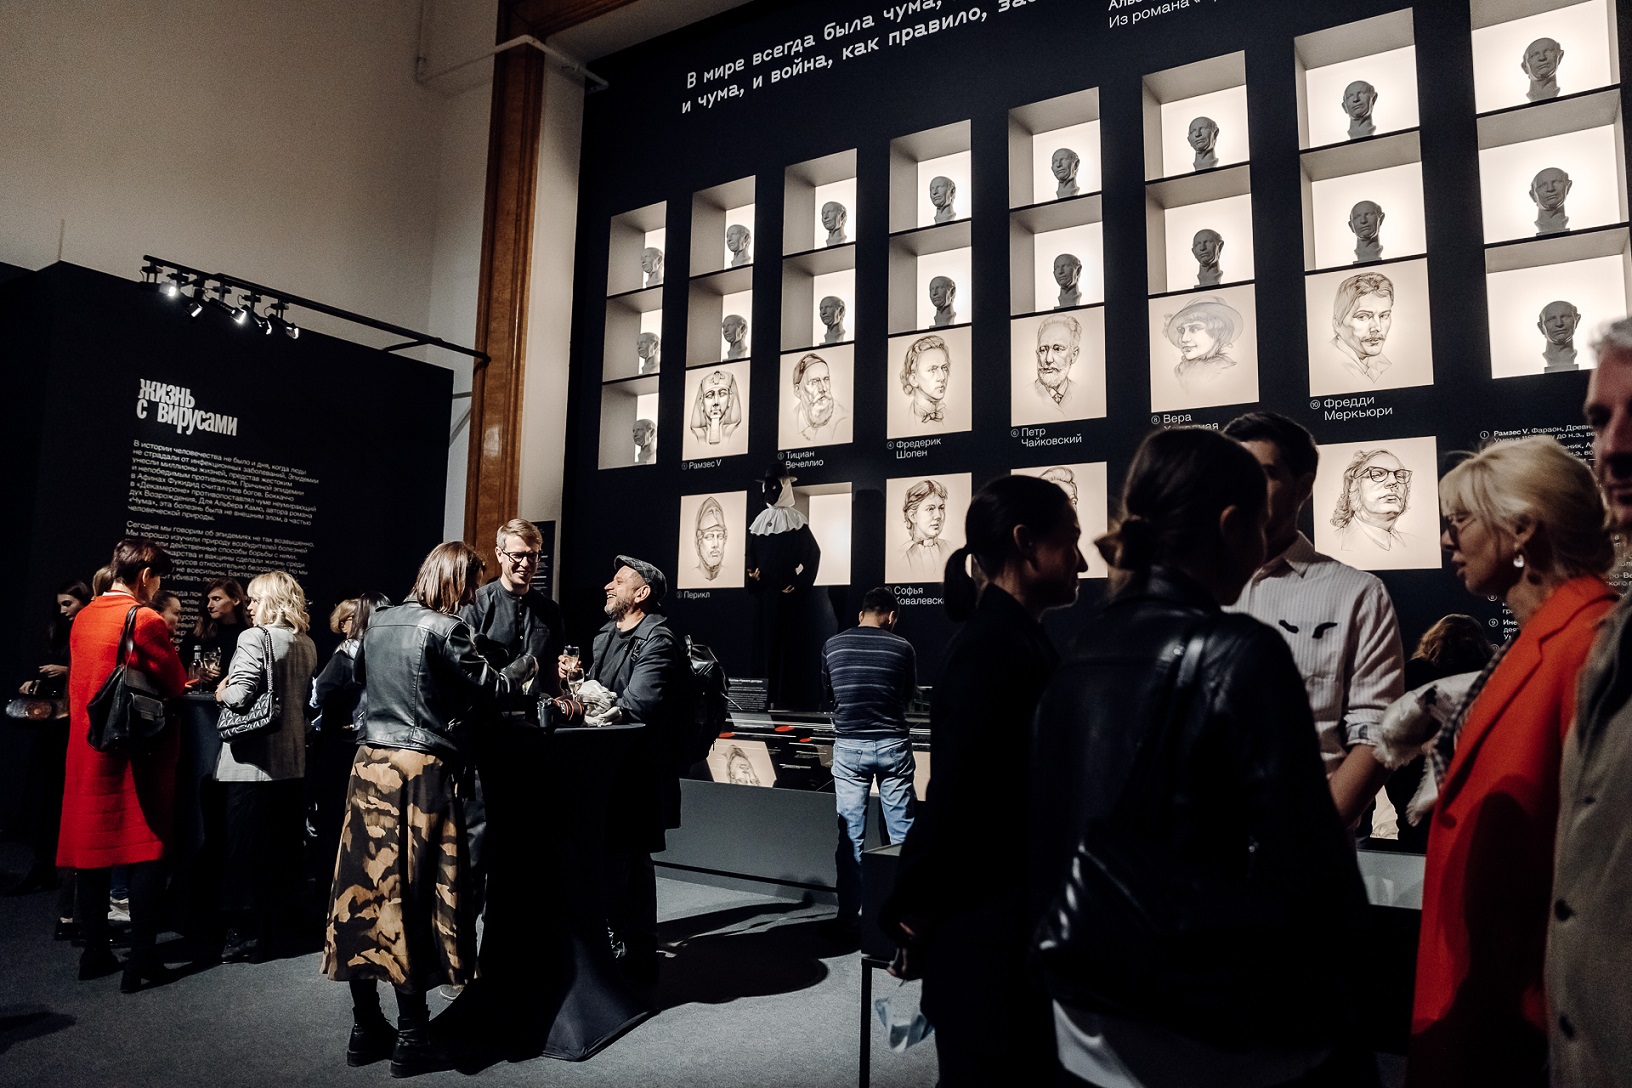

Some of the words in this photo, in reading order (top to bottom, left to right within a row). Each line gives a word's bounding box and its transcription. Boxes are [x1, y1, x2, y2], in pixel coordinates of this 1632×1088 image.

[1108, 14, 1129, 29] Из
[1132, 0, 1190, 25] романа
[686, 71, 697, 89] В
[703, 58, 745, 80] мире
[752, 34, 815, 66] всегда
[823, 15, 875, 41] была
[883, 0, 942, 22] чума,
[681, 100, 692, 114] и
[698, 84, 745, 108] чума,
[752, 75, 763, 89] и
[771, 54, 833, 84] война,
[842, 37, 880, 60] как
[888, 7, 988, 46] правило,
[1323, 396, 1375, 410] Фредди
[157, 402, 238, 436] вирусами
[1163, 413, 1192, 424] Вера
[1324, 407, 1393, 421] Меркьюри
[1021, 427, 1046, 437] Петр
[1493, 430, 1522, 438] Рамзес
[896, 438, 942, 449] Фредерик
[1021, 433, 1082, 447] Чайковский
[141, 443, 172, 452] истории
[173, 448, 222, 461] человечества
[233, 457, 250, 465] было
[786, 450, 815, 461] Тициан
[896, 450, 928, 460] Шопен
[144, 451, 180, 461] страдали
[191, 459, 241, 471] инфекционных
[288, 473, 319, 483] Эпидемии
[688, 460, 715, 470] Рамзес
[716, 459, 723, 468] V
[785, 459, 824, 469] Вечеллио
[161, 462, 198, 472] миллионы
[229, 473, 260, 482] представ
[262, 478, 292, 486] жестоким
[137, 473, 166, 483] Афинах
[168, 478, 200, 489] Фукидид
[201, 483, 225, 491] считал
[138, 467, 190, 478] непобедимым
[240, 480, 272, 490] Причиной
[274, 487, 304, 495] эпидемии
[174, 502, 204, 511] болезнь
[205, 506, 223, 514] была
[214, 500, 243, 509] Альбера
[273, 502, 316, 512] неумирающий
[128, 506, 180, 516] человеческой
[127, 521, 159, 530] Сегодня
[173, 527, 204, 535] говорим
[215, 532, 251, 540] эпидемиях
[170, 543, 217, 552] действенные
[171, 535, 200, 543] изучили
[202, 538, 231, 546] природу
[232, 541, 277, 550] возбудителей
[278, 545, 308, 553] болезней
[199, 561, 246, 570] относительно
[172, 574, 201, 582] убивать
[683, 590, 711, 600] Перикл
[893, 585, 924, 597] Софья
[896, 596, 944, 605] овалевск
